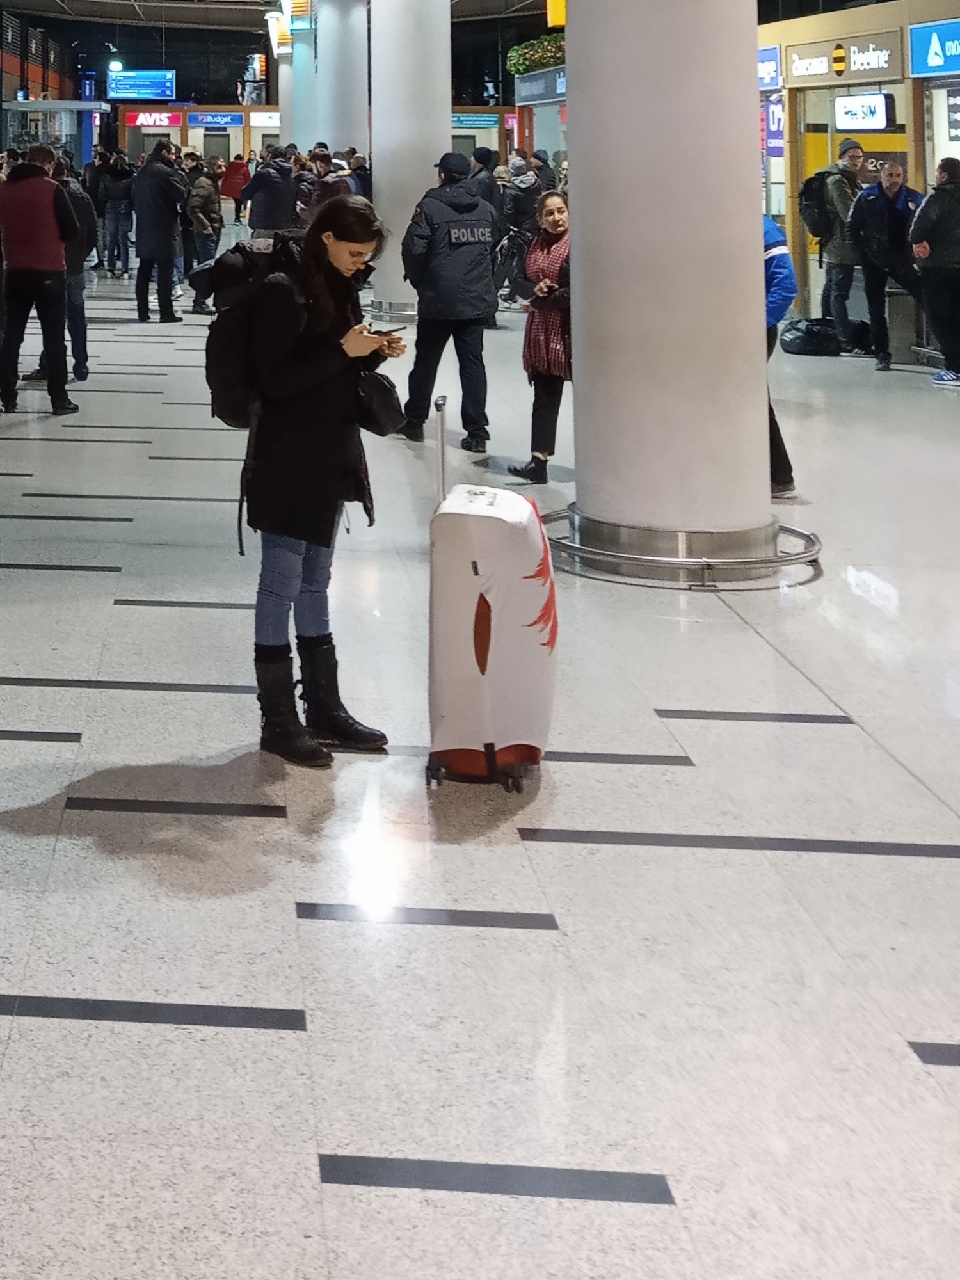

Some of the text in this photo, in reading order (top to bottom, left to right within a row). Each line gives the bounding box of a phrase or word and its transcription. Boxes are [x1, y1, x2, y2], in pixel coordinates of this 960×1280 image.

[850, 44, 890, 71] Beeline
[135, 113, 170, 126] AVIS
[206, 115, 232, 125] Budget
[451, 227, 492, 243] POLICE
